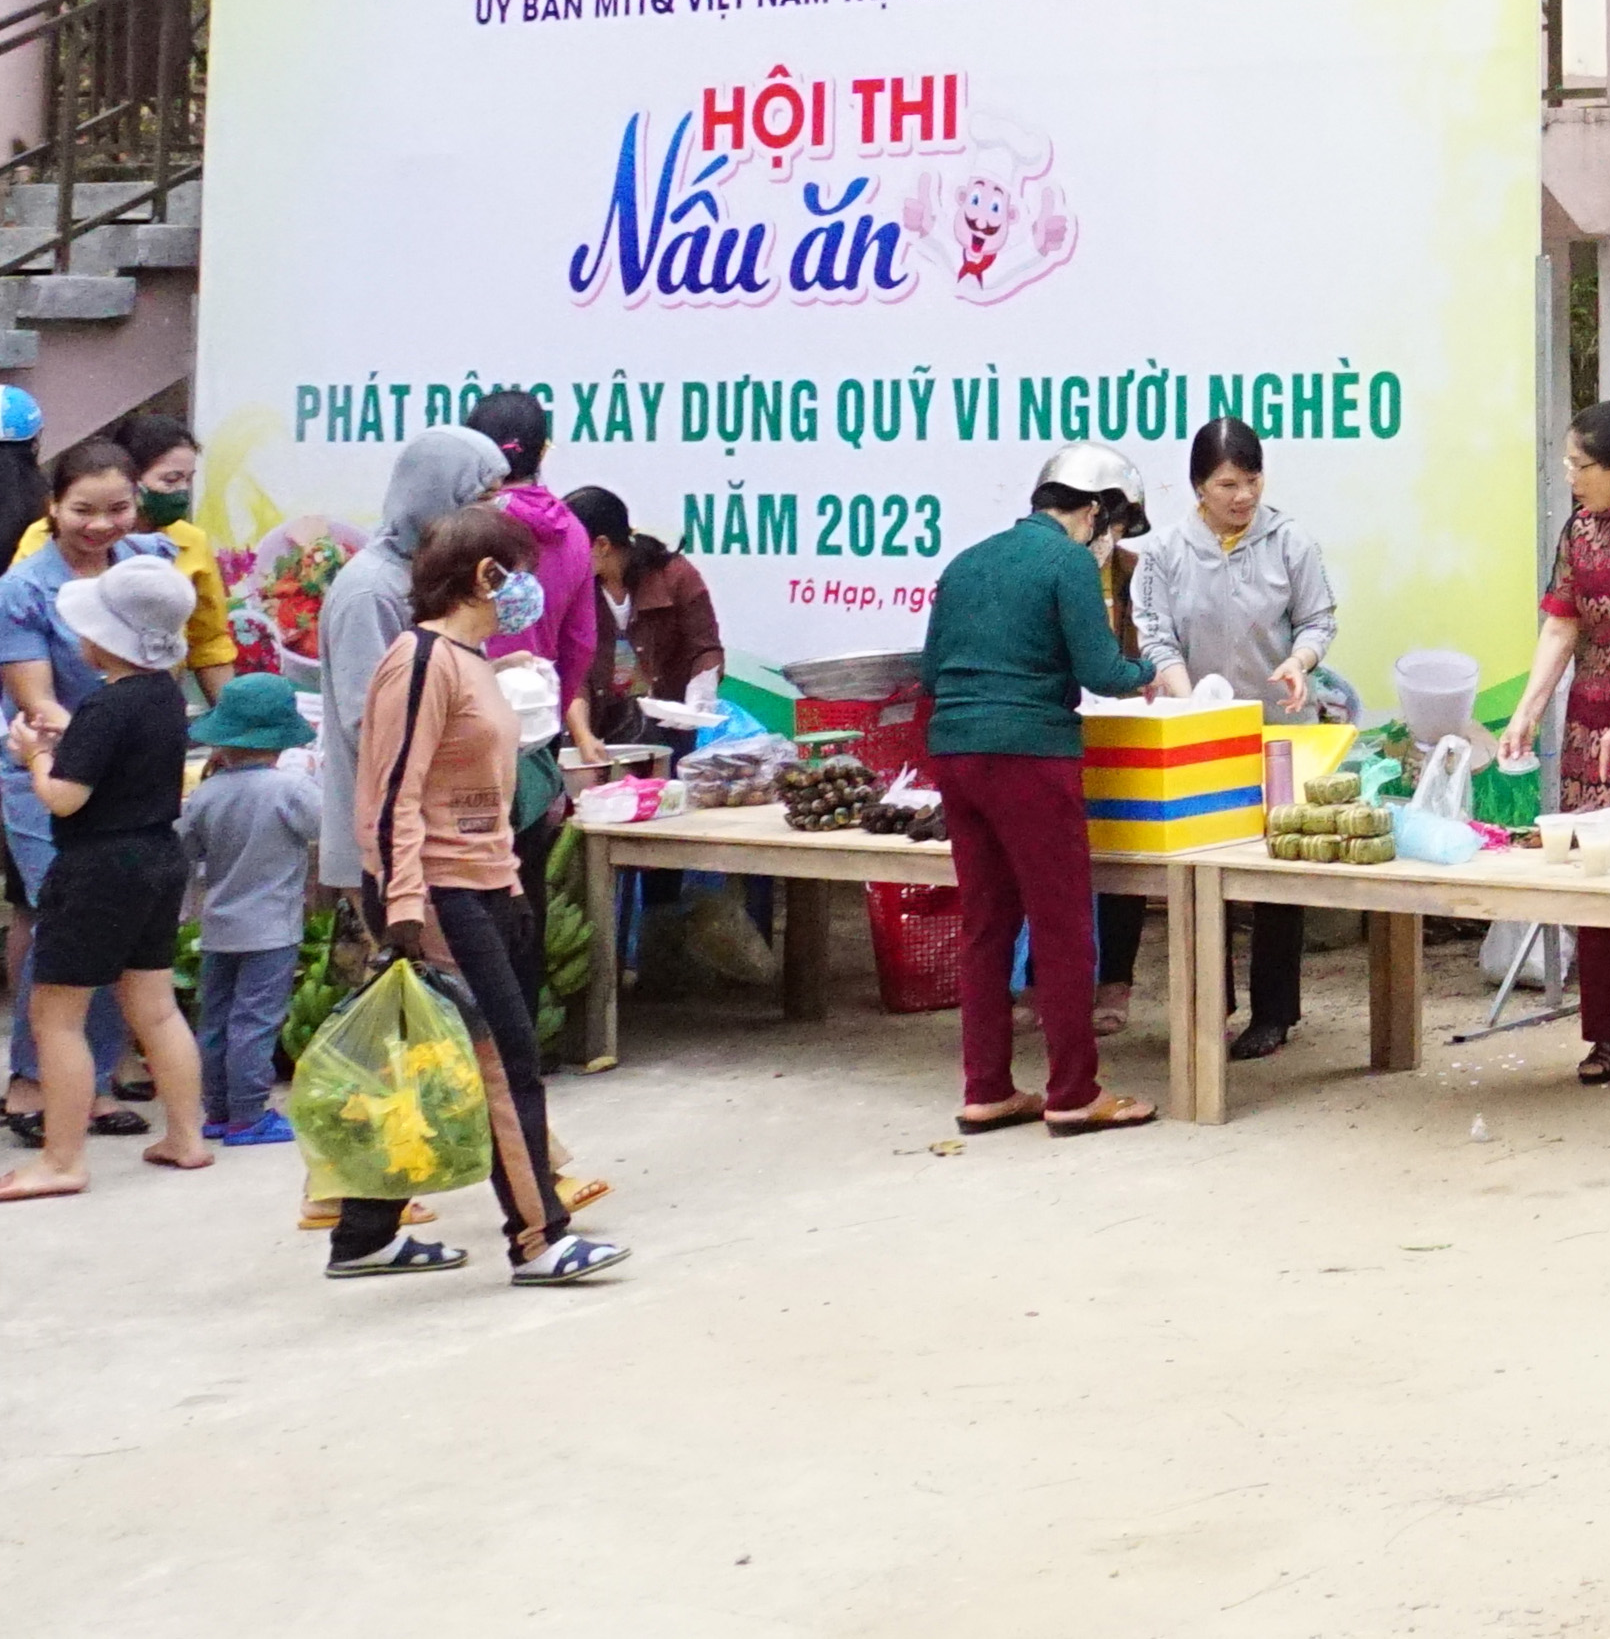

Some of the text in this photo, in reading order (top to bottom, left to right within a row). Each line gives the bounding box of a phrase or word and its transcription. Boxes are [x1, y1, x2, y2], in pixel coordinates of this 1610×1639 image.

[703, 64, 957, 168] HỘI THI
[569, 110, 908, 295] Nấu ăn
[296, 371, 411, 442] PHÁT
[571, 369, 664, 442] XÂY
[682, 374, 817, 456] DỰNG
[837, 365, 935, 449] QUỸ
[952, 363, 999, 441] VÌ
[1019, 359, 1187, 441] NGƯỜI
[1209, 357, 1402, 439] NGHÈO
[684, 479, 941, 557] NĂM 2023
[789, 578, 815, 604] Tô
[823, 580, 883, 611] Hạp,
